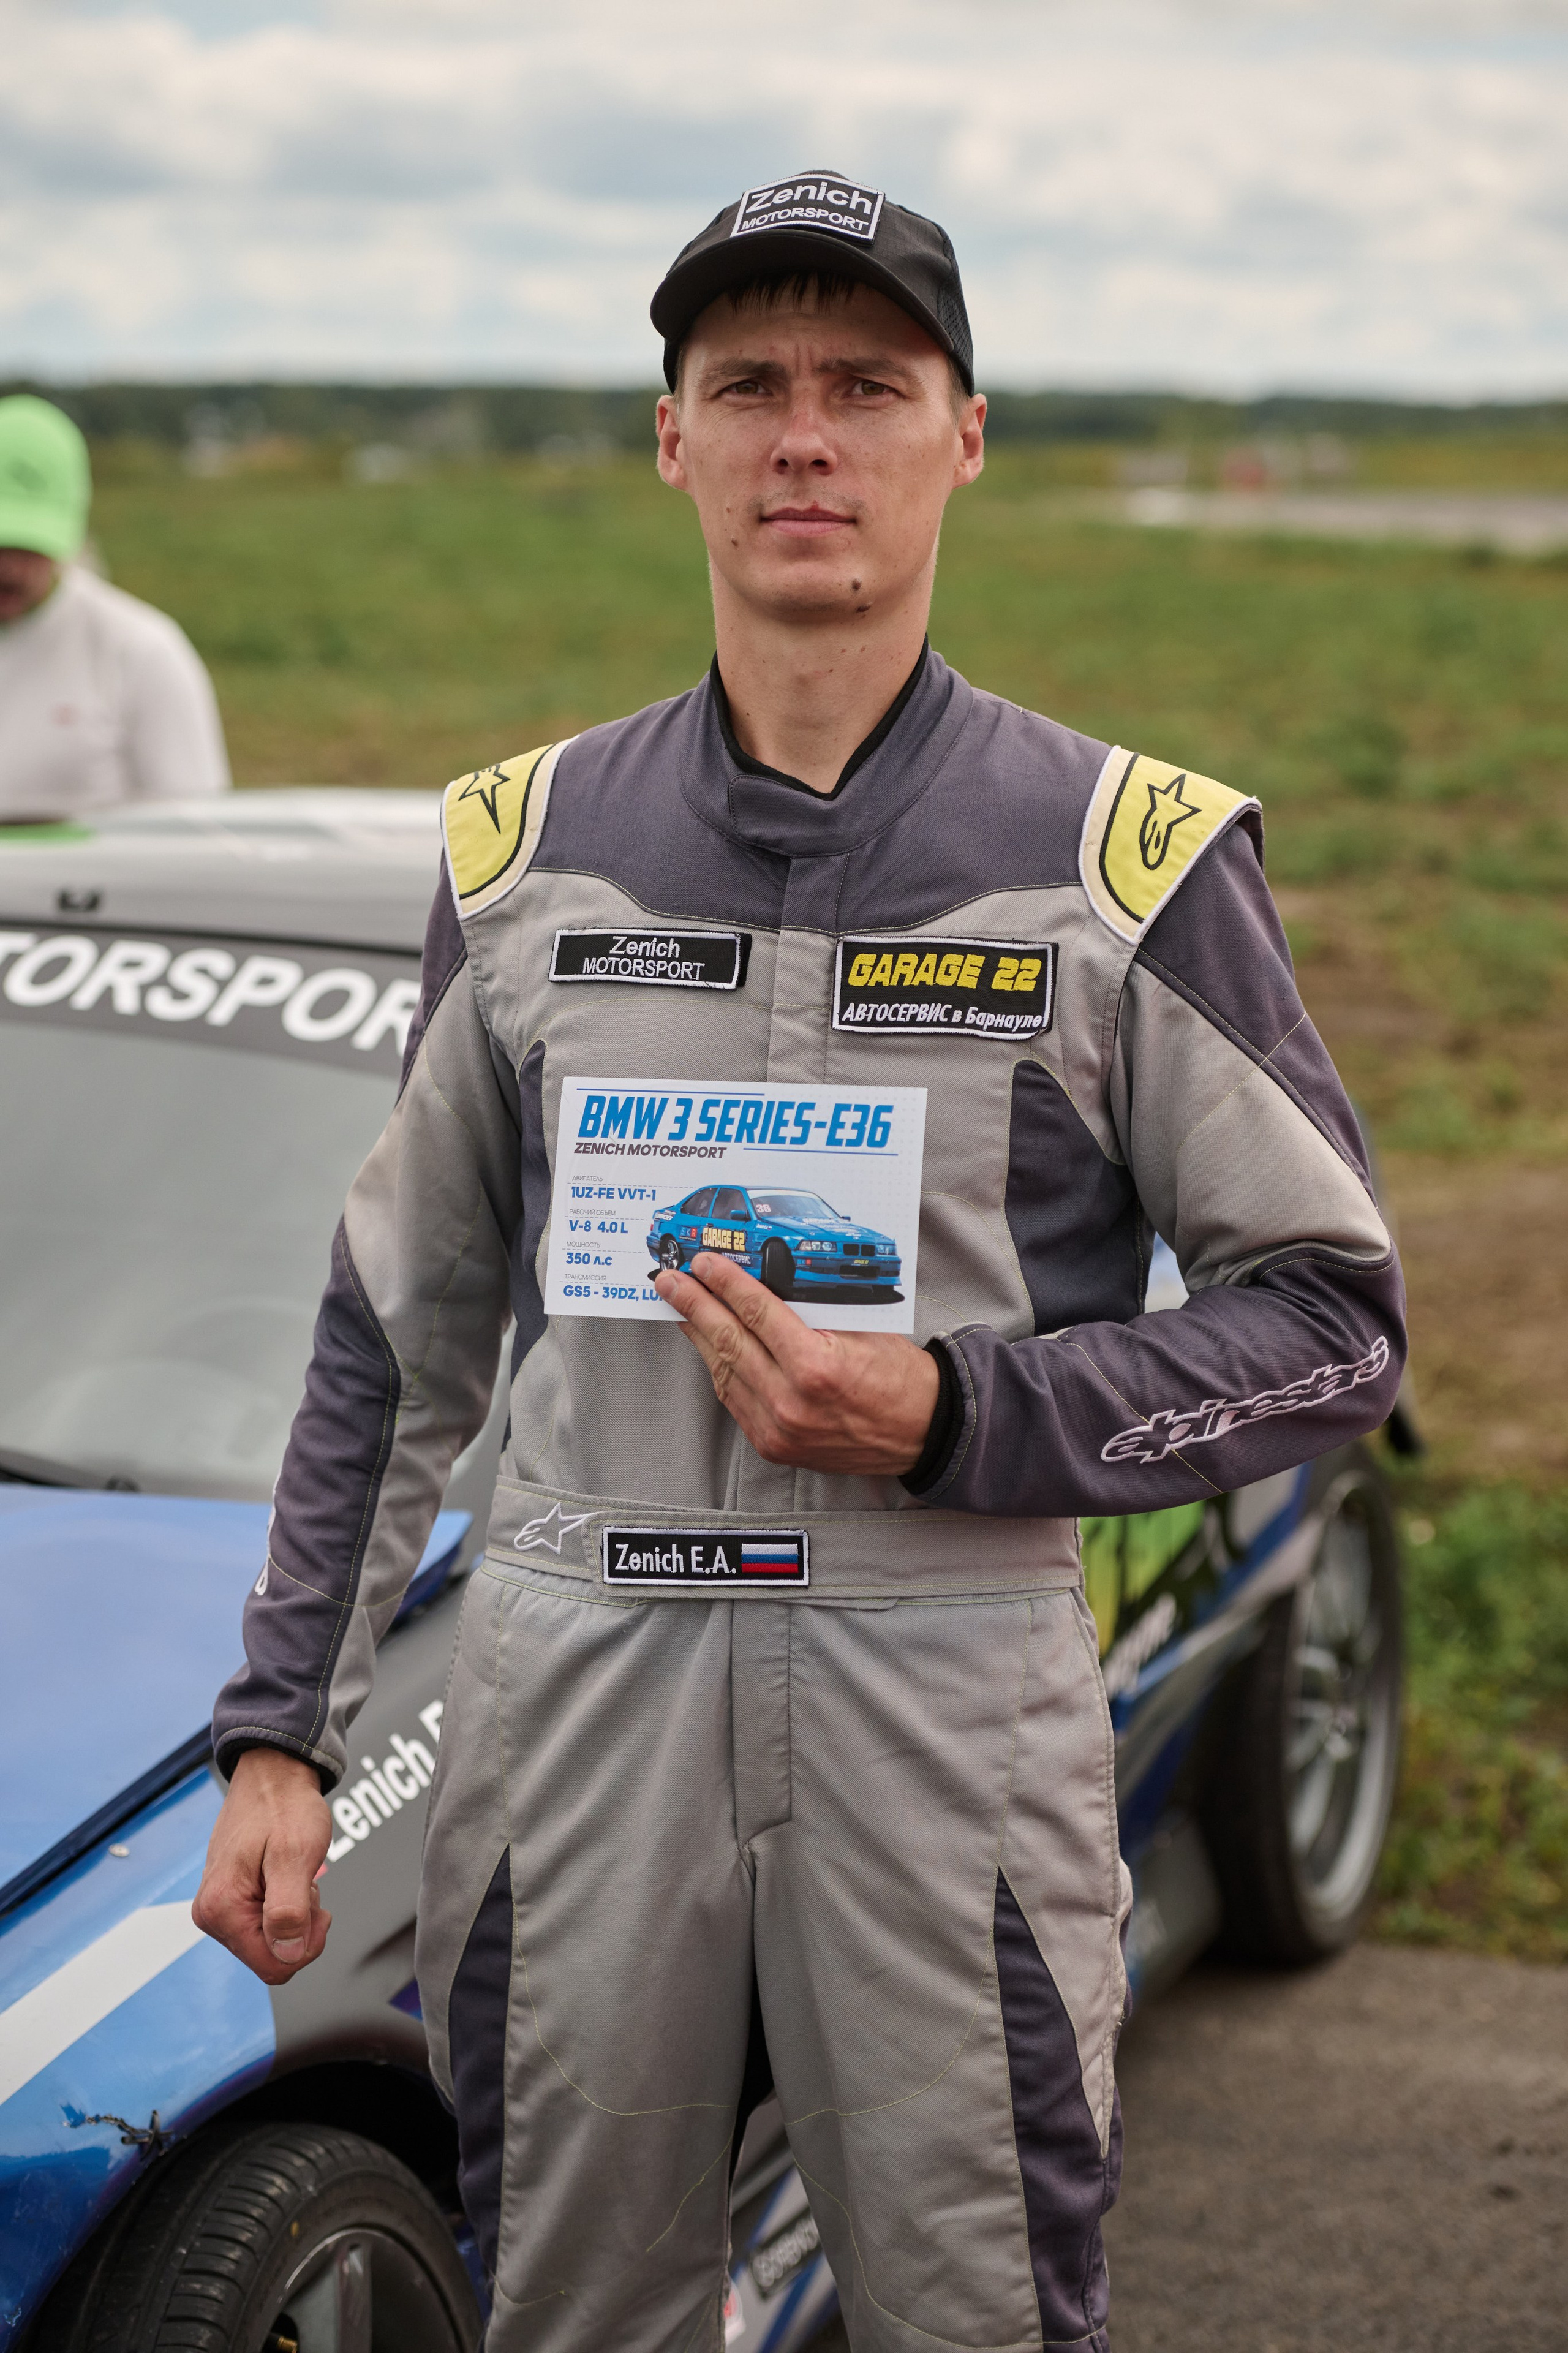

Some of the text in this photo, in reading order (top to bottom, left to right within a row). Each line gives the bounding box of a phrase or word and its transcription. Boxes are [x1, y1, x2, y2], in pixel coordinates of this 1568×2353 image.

[745, 181, 871, 215] Zenich
[741, 206, 869, 231] MOTORSPORT
[609, 935, 680, 958] Zenich
[582, 957, 705, 980] MOTORSPORT
[848, 953, 1042, 991] GARAGE 22
[842, 1002, 1043, 1033] АВТОСЕРВИС в Барнауле
[578, 1095, 894, 1149] BMW 3 SERIES-E36
[574, 1141, 728, 1159] ZENICH MOTORSPORT
[571, 1186, 656, 1201] 1UZ-FE VVT-1
[755, 1204, 772, 1213] 36
[568, 1220, 628, 1234] V-8 4.0 L
[702, 1227, 745, 1252] GARAGE 22
[565, 1252, 612, 1266] 350 л.с
[564, 1273, 606, 1282] ТРАНСМИССИЯ
[563, 1285, 591, 1298] GS5
[601, 1286, 639, 1302] 39DZ,
[641, 1288, 663, 1301] LU
[615, 1543, 736, 1574] Zenich E.A.
[325, 1733, 437, 1863] enich
